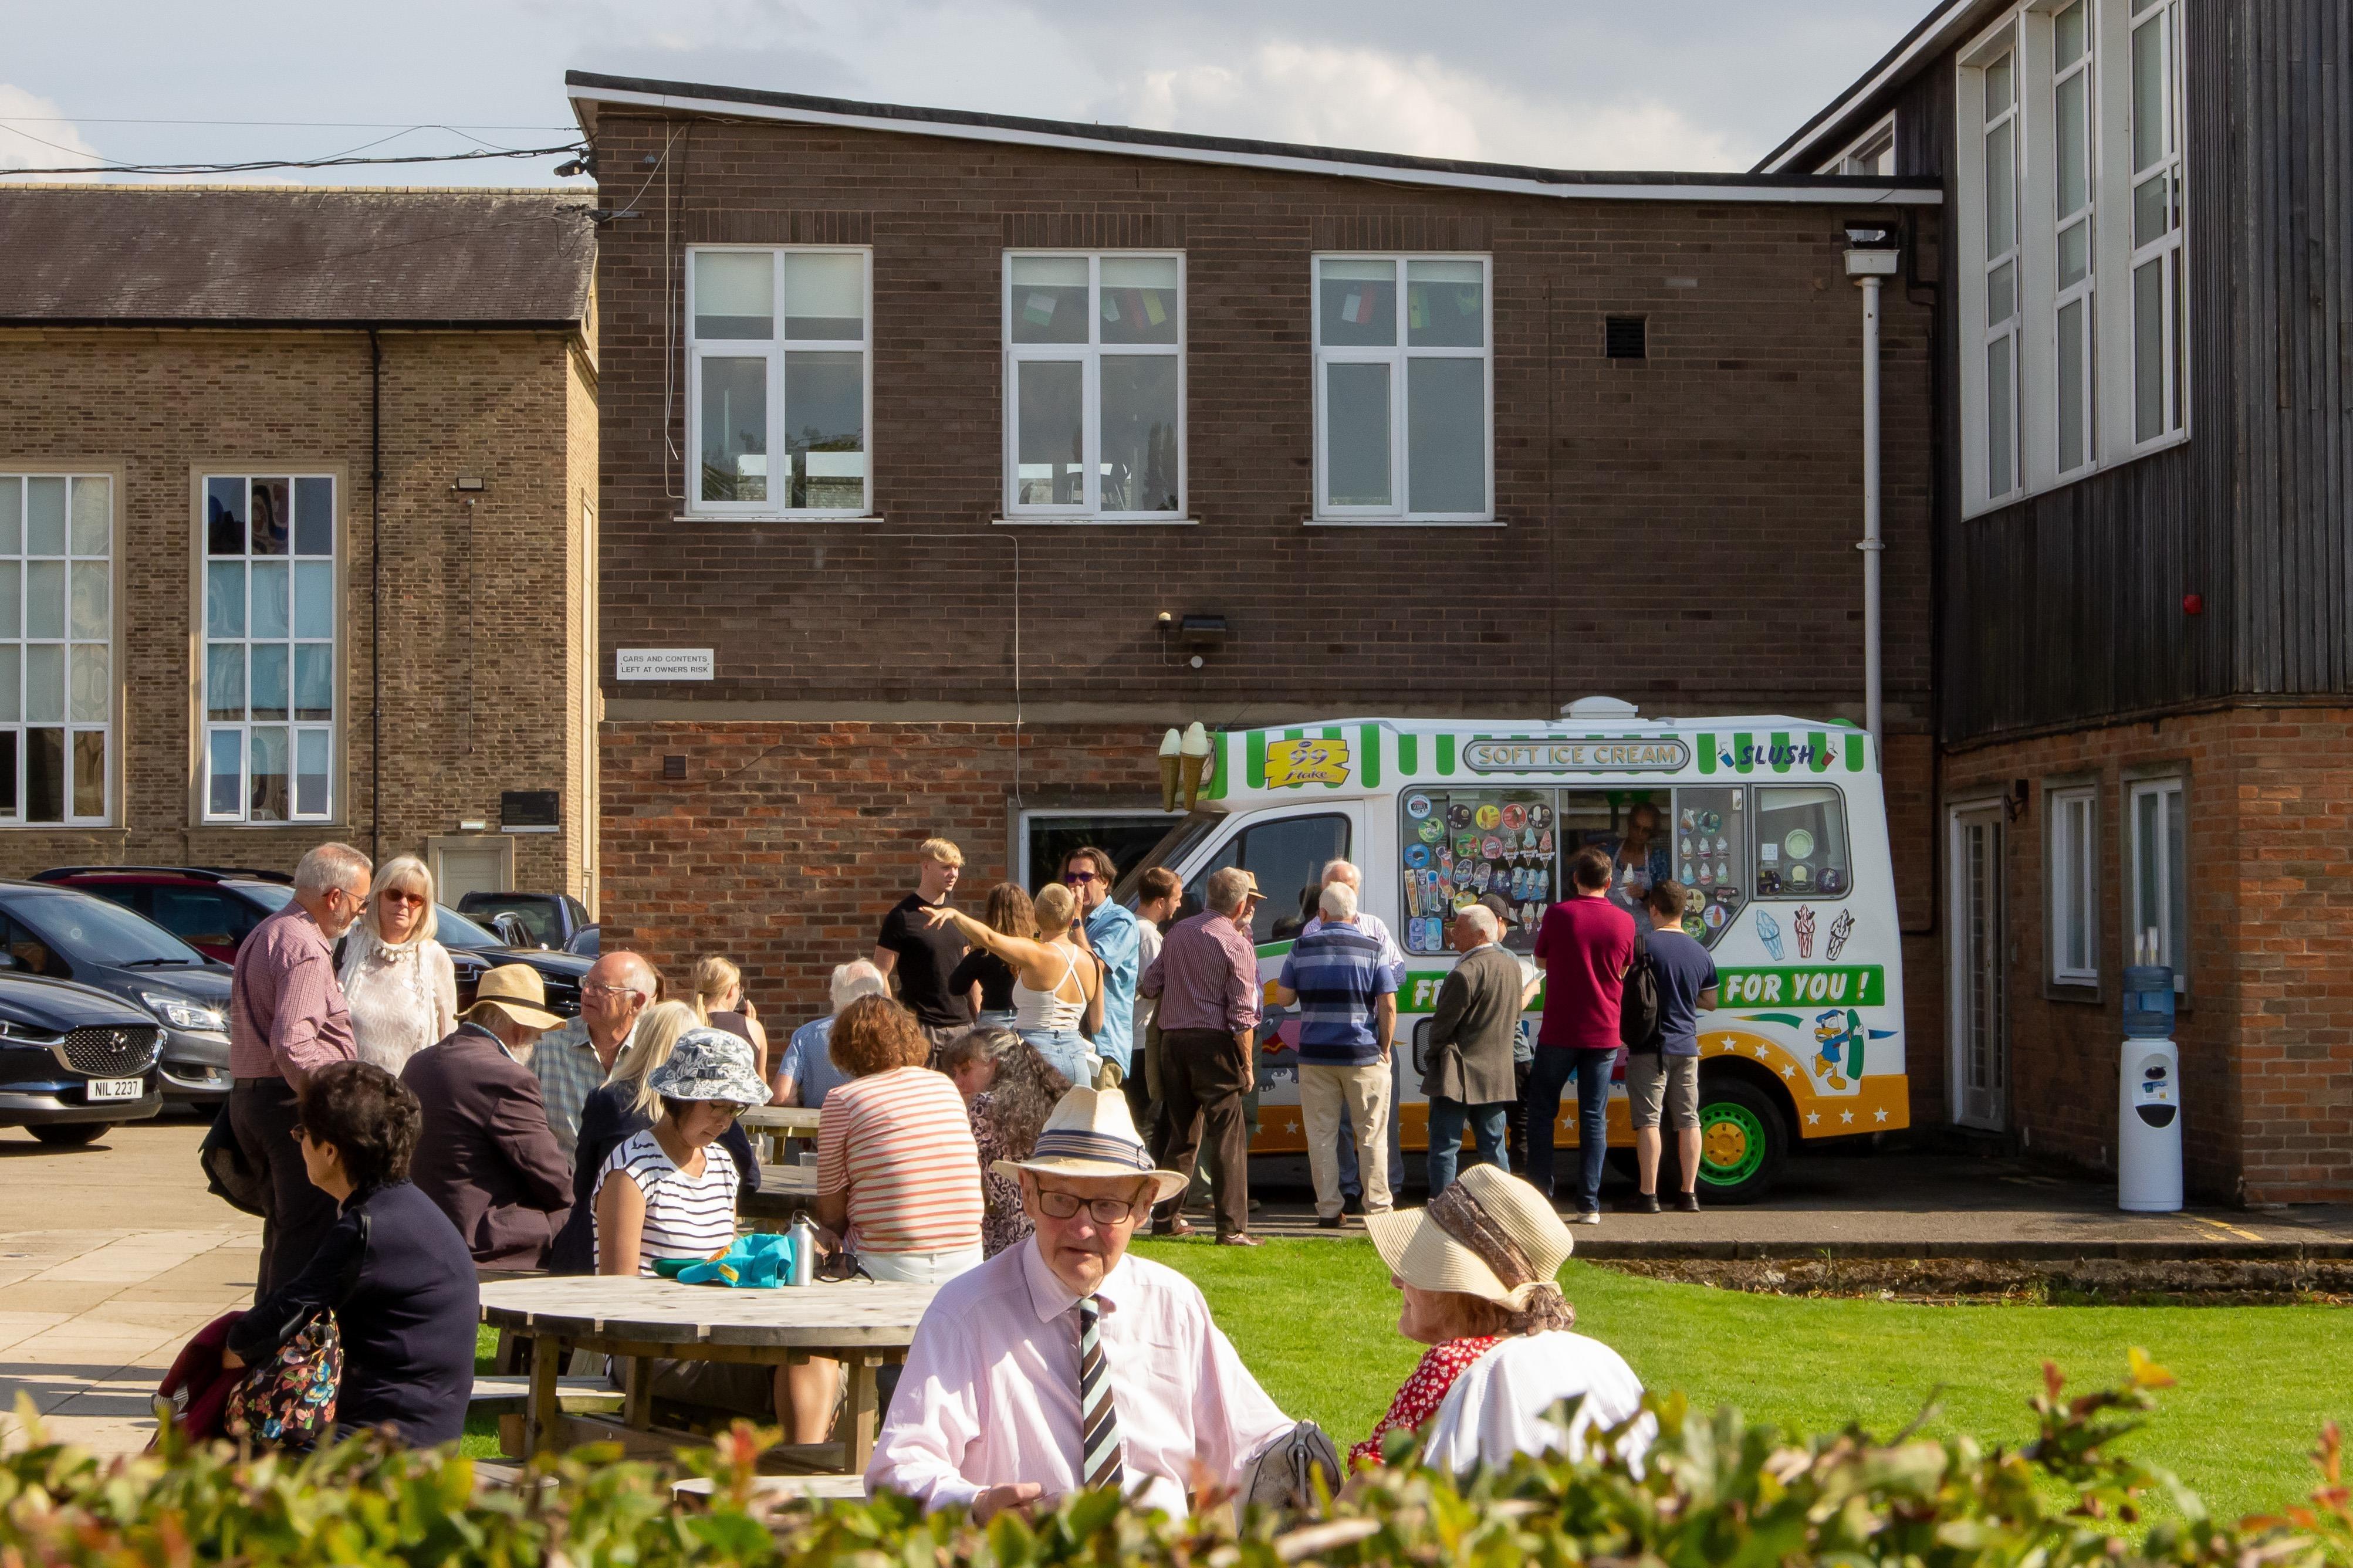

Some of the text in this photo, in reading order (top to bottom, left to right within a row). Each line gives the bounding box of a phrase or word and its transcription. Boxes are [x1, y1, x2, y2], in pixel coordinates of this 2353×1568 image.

[1289, 749, 1328, 766] 99
[1478, 746, 1676, 764] SOFT ICE CREAM
[1740, 744, 1816, 765] SLUSH
[1283, 767, 1327, 781] Flake
[1725, 974, 1782, 1003] FOR
[1792, 973, 1847, 1002] YOU
[95, 1081, 138, 1096] NIL 2237
